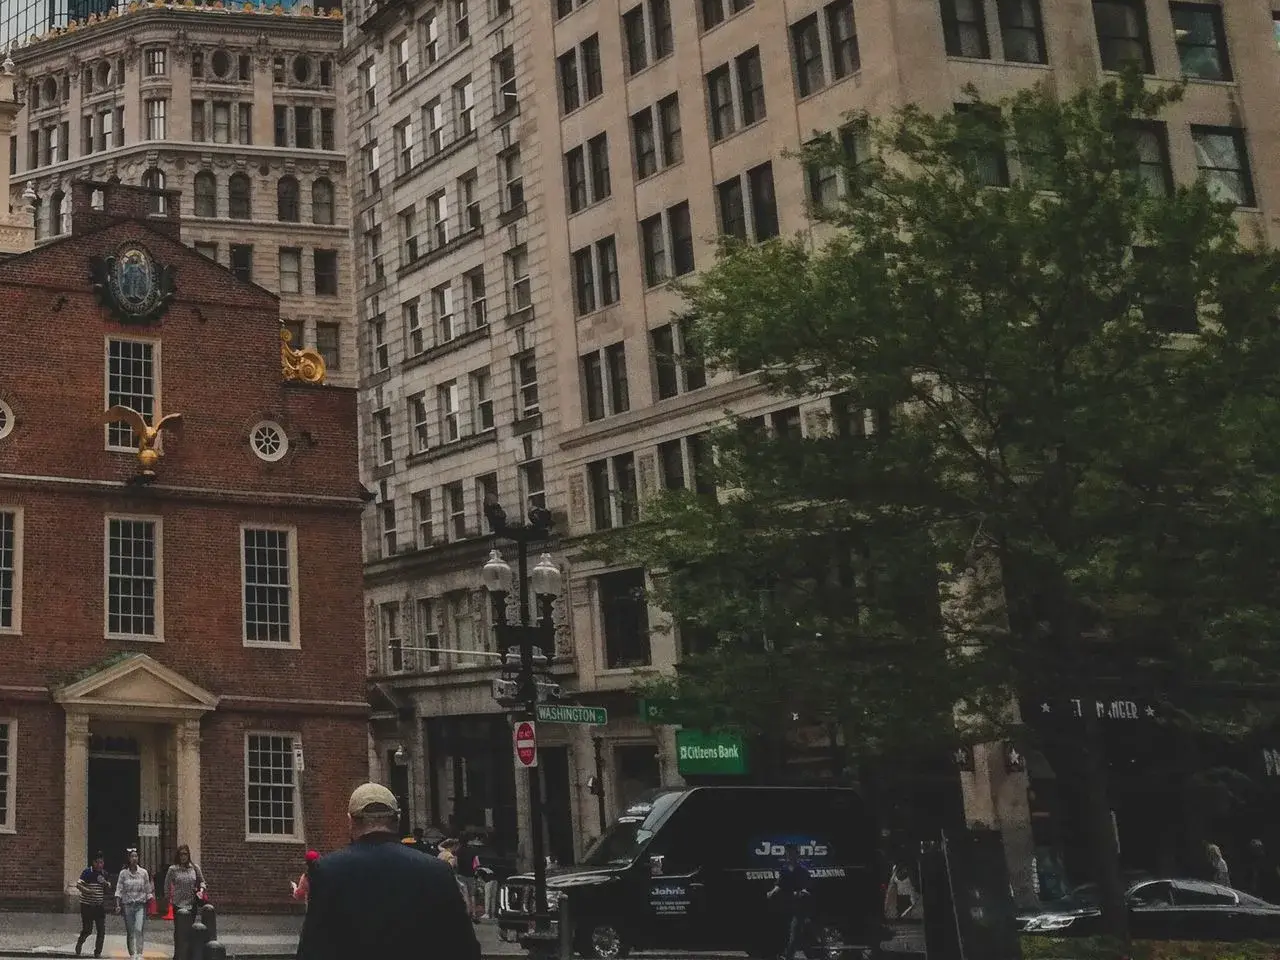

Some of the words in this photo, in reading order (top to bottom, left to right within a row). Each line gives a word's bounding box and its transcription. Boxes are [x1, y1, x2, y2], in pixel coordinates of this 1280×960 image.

[538, 707, 596, 722] WASHINGTON
[688, 746, 718, 759] Citizens
[718, 744, 739, 758] Bank
[755, 839, 828, 856] Jon's
[746, 871, 774, 880] SEWER
[651, 887, 686, 896] John's
